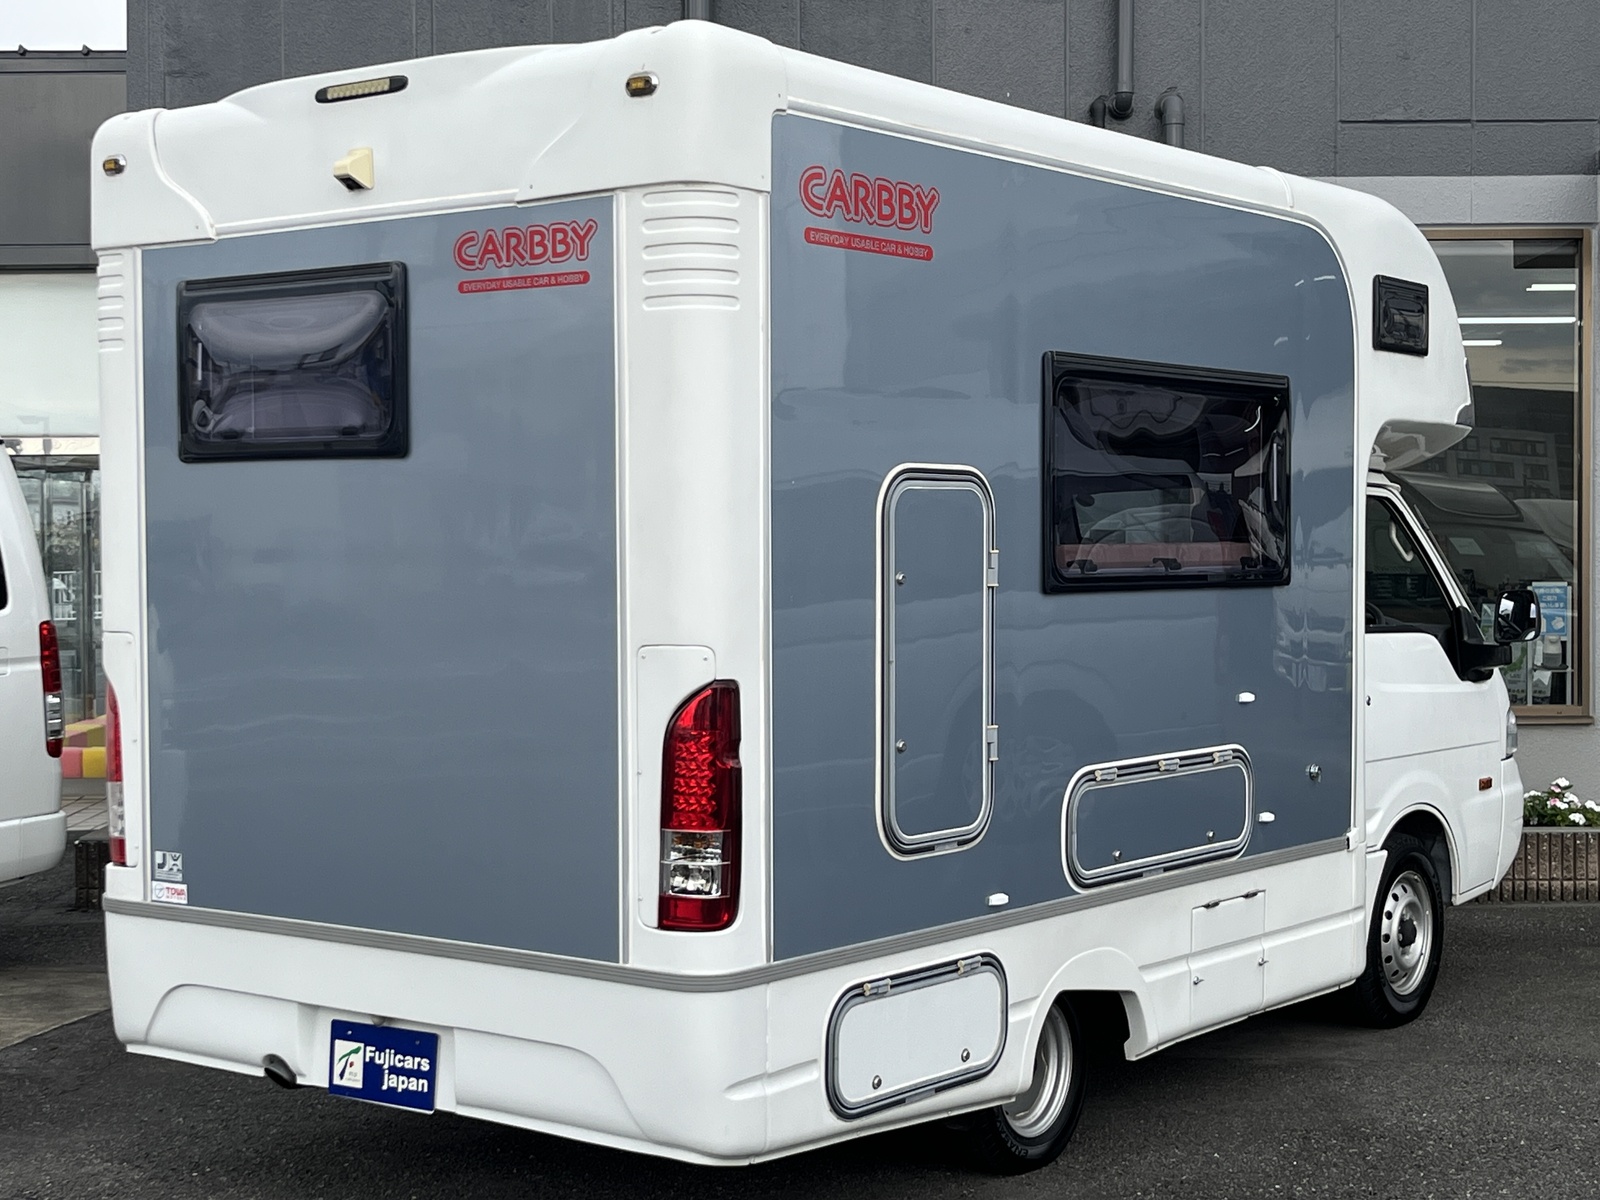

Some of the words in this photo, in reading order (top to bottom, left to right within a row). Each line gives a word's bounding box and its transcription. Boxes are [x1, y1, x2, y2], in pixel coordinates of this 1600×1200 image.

[799, 165, 940, 234] CARBBY
[453, 218, 598, 271] CARBBY
[809, 231, 849, 246] EVERYDAY
[851, 237, 880, 251] USABLE
[880, 241, 896, 253] CAR
[897, 243, 902, 254] &
[903, 245, 929, 258] HOBBY
[463, 280, 501, 292] EVERYDAY
[502, 278, 532, 289] USABLE
[532, 276, 550, 286] CAR
[550, 276, 556, 285] &
[556, 273, 585, 284] HOBBY
[365, 1045, 431, 1072] Fujicars
[381, 1069, 428, 1093] japan
